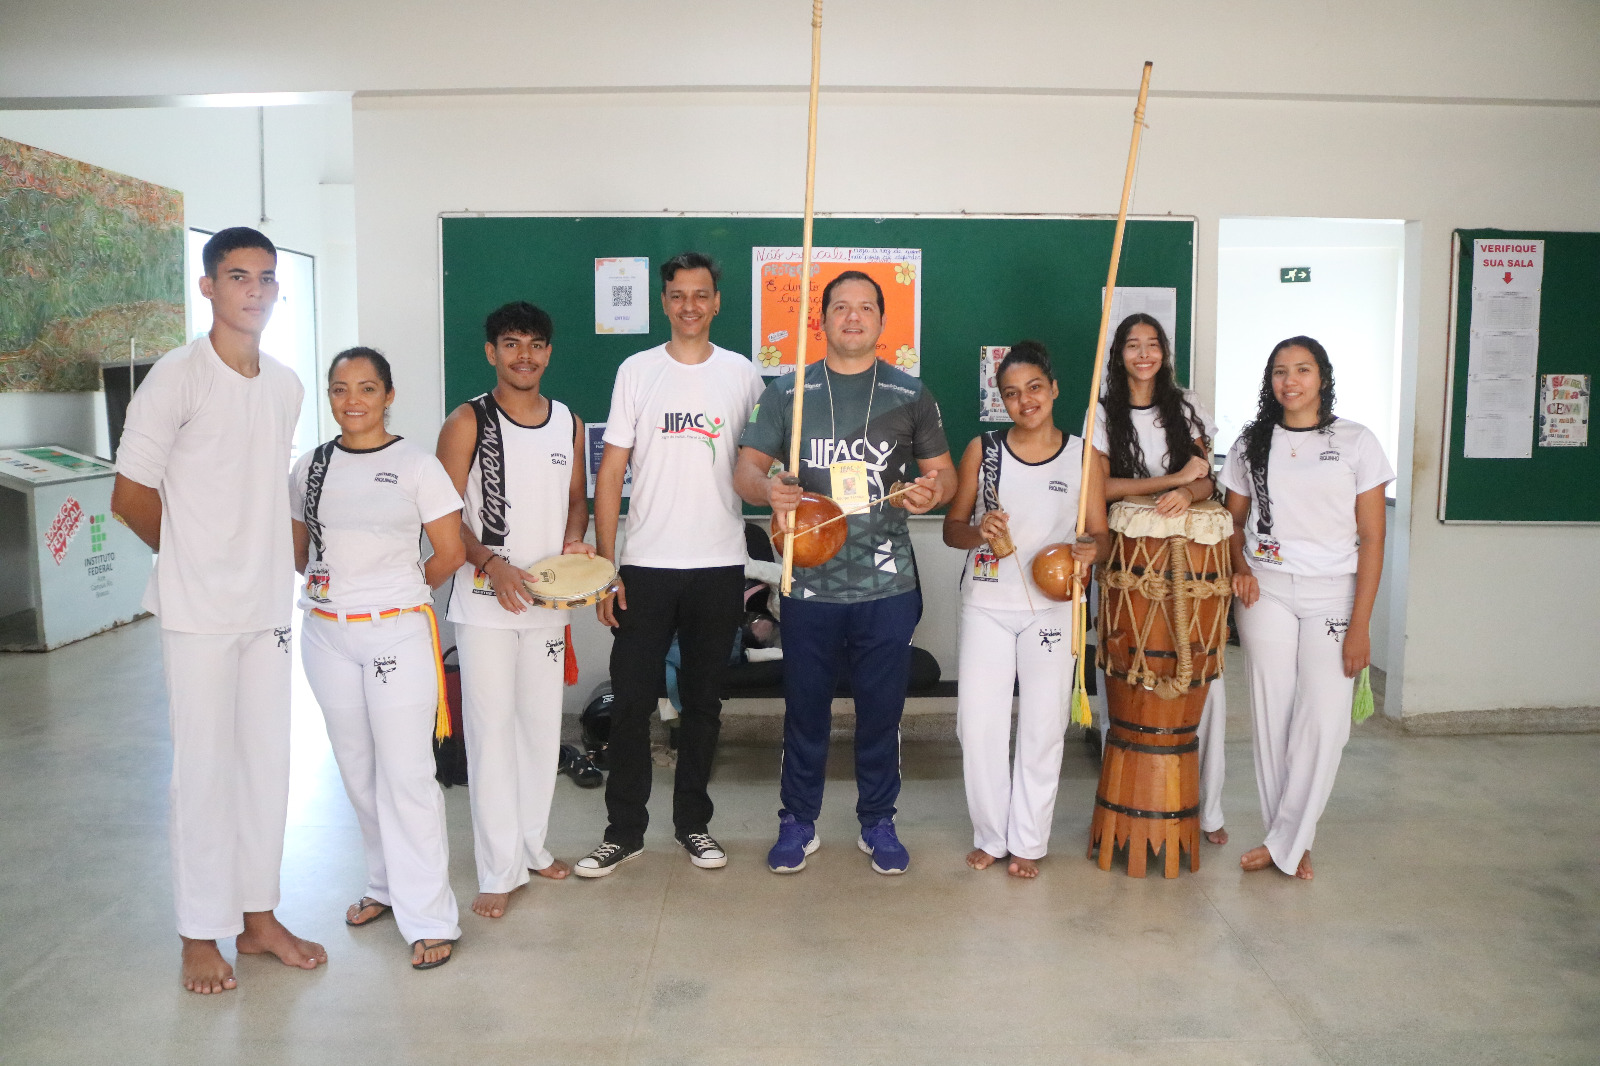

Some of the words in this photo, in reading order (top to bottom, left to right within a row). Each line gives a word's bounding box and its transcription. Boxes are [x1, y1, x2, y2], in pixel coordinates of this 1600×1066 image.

[1480, 244, 1537, 254] VERIFIQUE
[1482, 259, 1505, 268] SUA
[1507, 259, 1534, 268] SALA
[662, 412, 704, 433] JIFAC
[808, 438, 865, 468] JIFAC
[478, 398, 512, 537] Capoeira
[84, 552, 115, 567] INSTITUTO
[88, 563, 113, 576] FEDERAL
